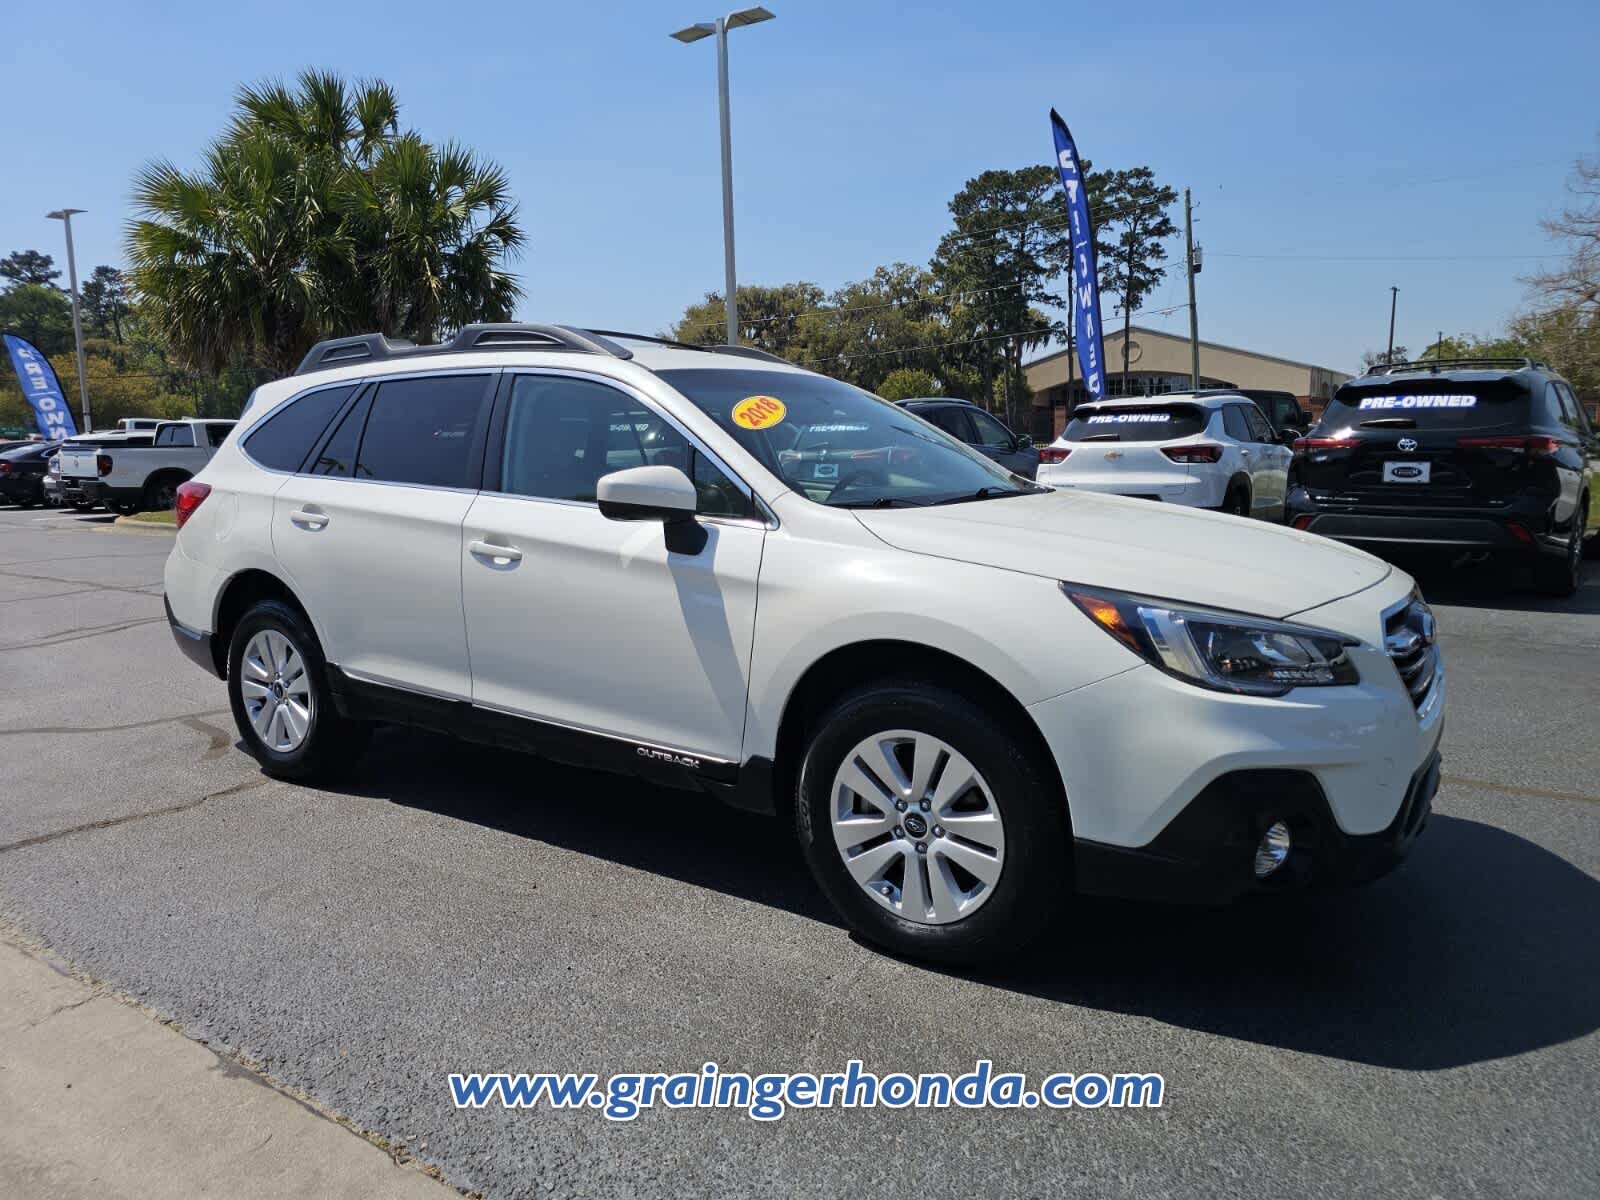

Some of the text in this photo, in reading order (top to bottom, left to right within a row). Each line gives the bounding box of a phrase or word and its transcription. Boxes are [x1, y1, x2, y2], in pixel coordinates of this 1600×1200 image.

[1359, 395, 1477, 409] PRE-OWNED
[739, 397, 780, 427] 2018
[1087, 414, 1170, 424] PRE-OWNED
[636, 747, 700, 769] OUTBACK
